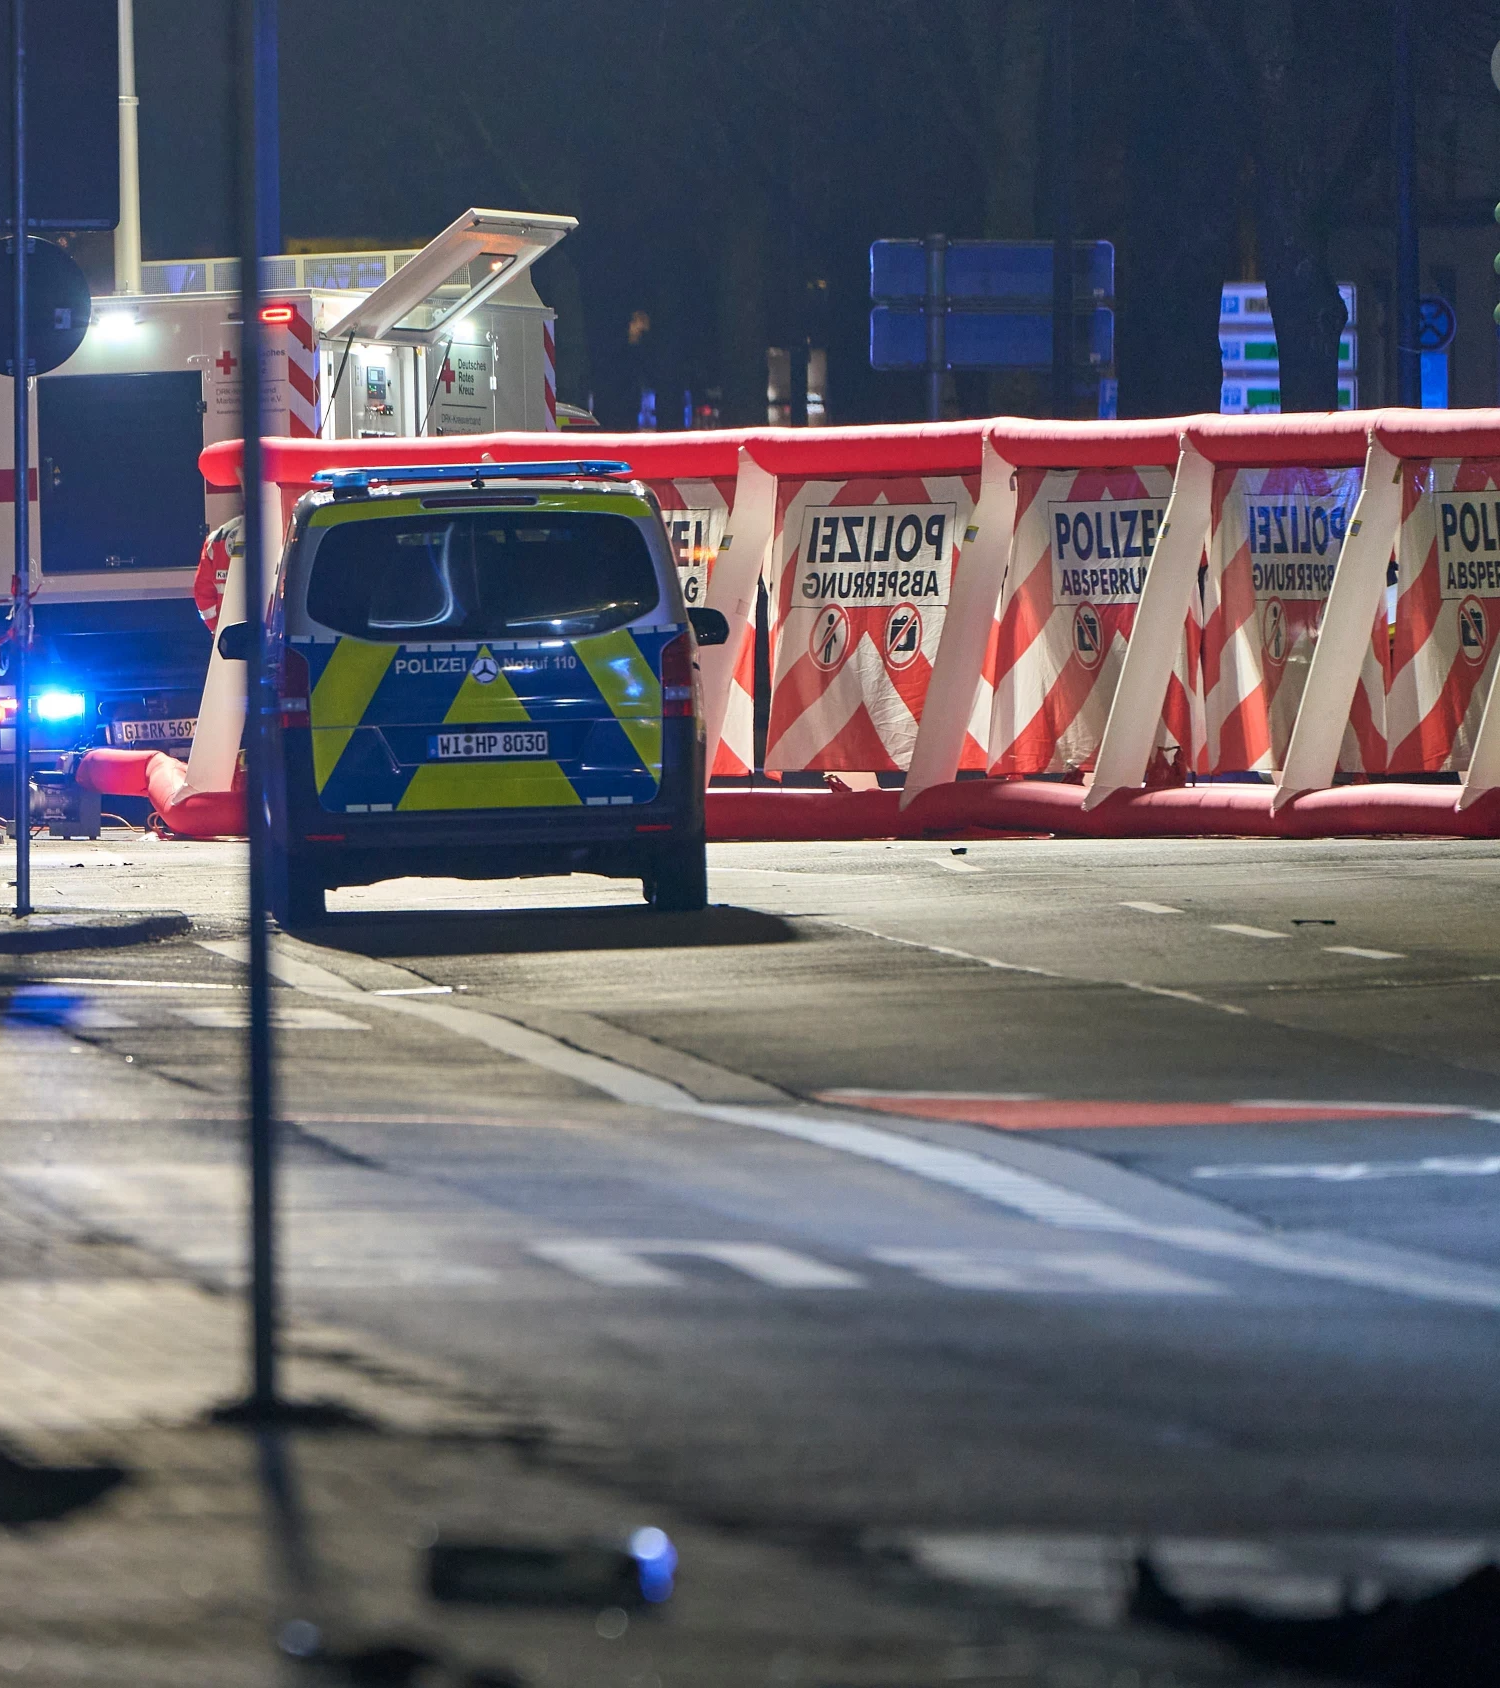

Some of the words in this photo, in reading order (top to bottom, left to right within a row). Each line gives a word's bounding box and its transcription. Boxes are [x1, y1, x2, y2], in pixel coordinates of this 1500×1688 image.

[458, 359, 487, 371] Deutsches
[458, 372, 475, 383] Rotes
[458, 384, 475, 395] Kreuz
[395, 657, 467, 674] POLIZEI
[503, 656, 548, 669] Notruf
[553, 656, 576, 669] 110
[125, 723, 140, 740] GI
[150, 722, 166, 738] RK
[440, 736, 462, 755] WI
[475, 735, 497, 754] HP
[503, 733, 546, 753] 8030
